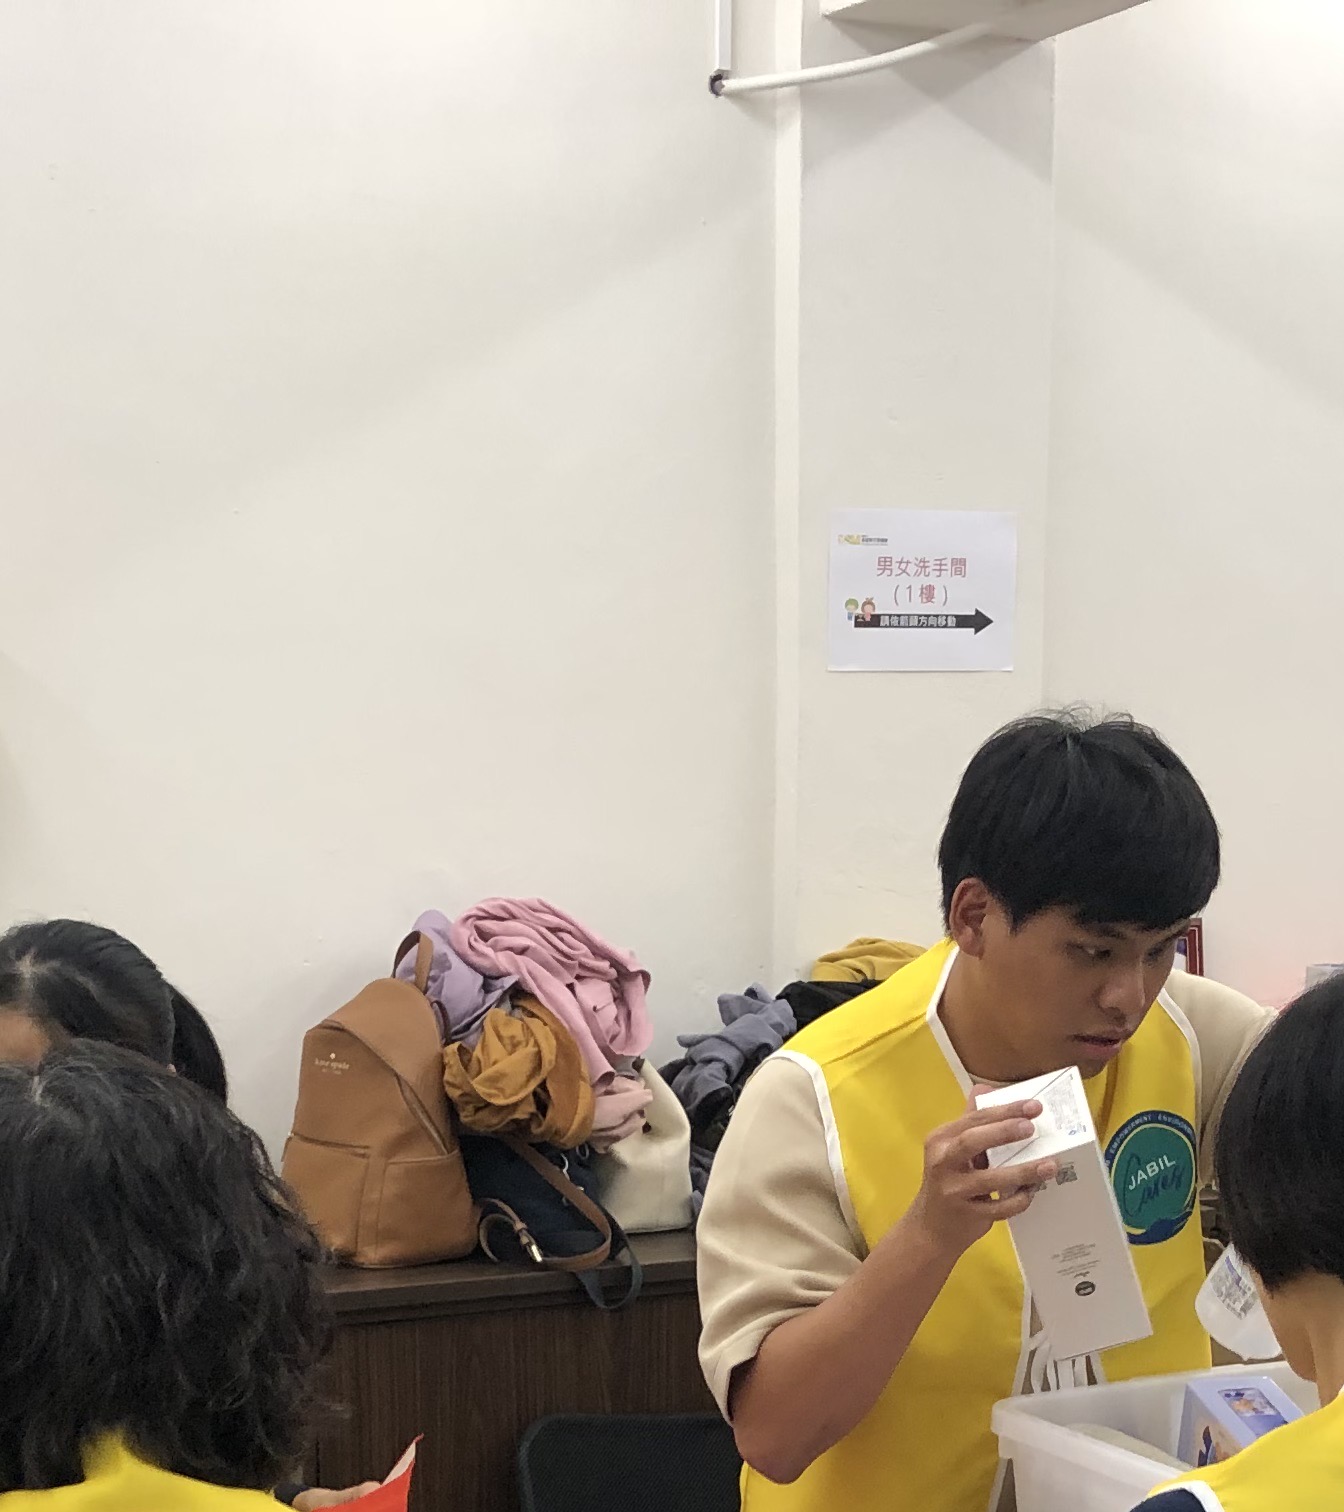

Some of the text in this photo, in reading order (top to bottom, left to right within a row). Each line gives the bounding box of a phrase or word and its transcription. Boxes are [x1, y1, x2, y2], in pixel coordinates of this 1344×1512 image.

[876, 556, 967, 578] 男女洗手間
[1128, 1154, 1176, 1191] JABIL
